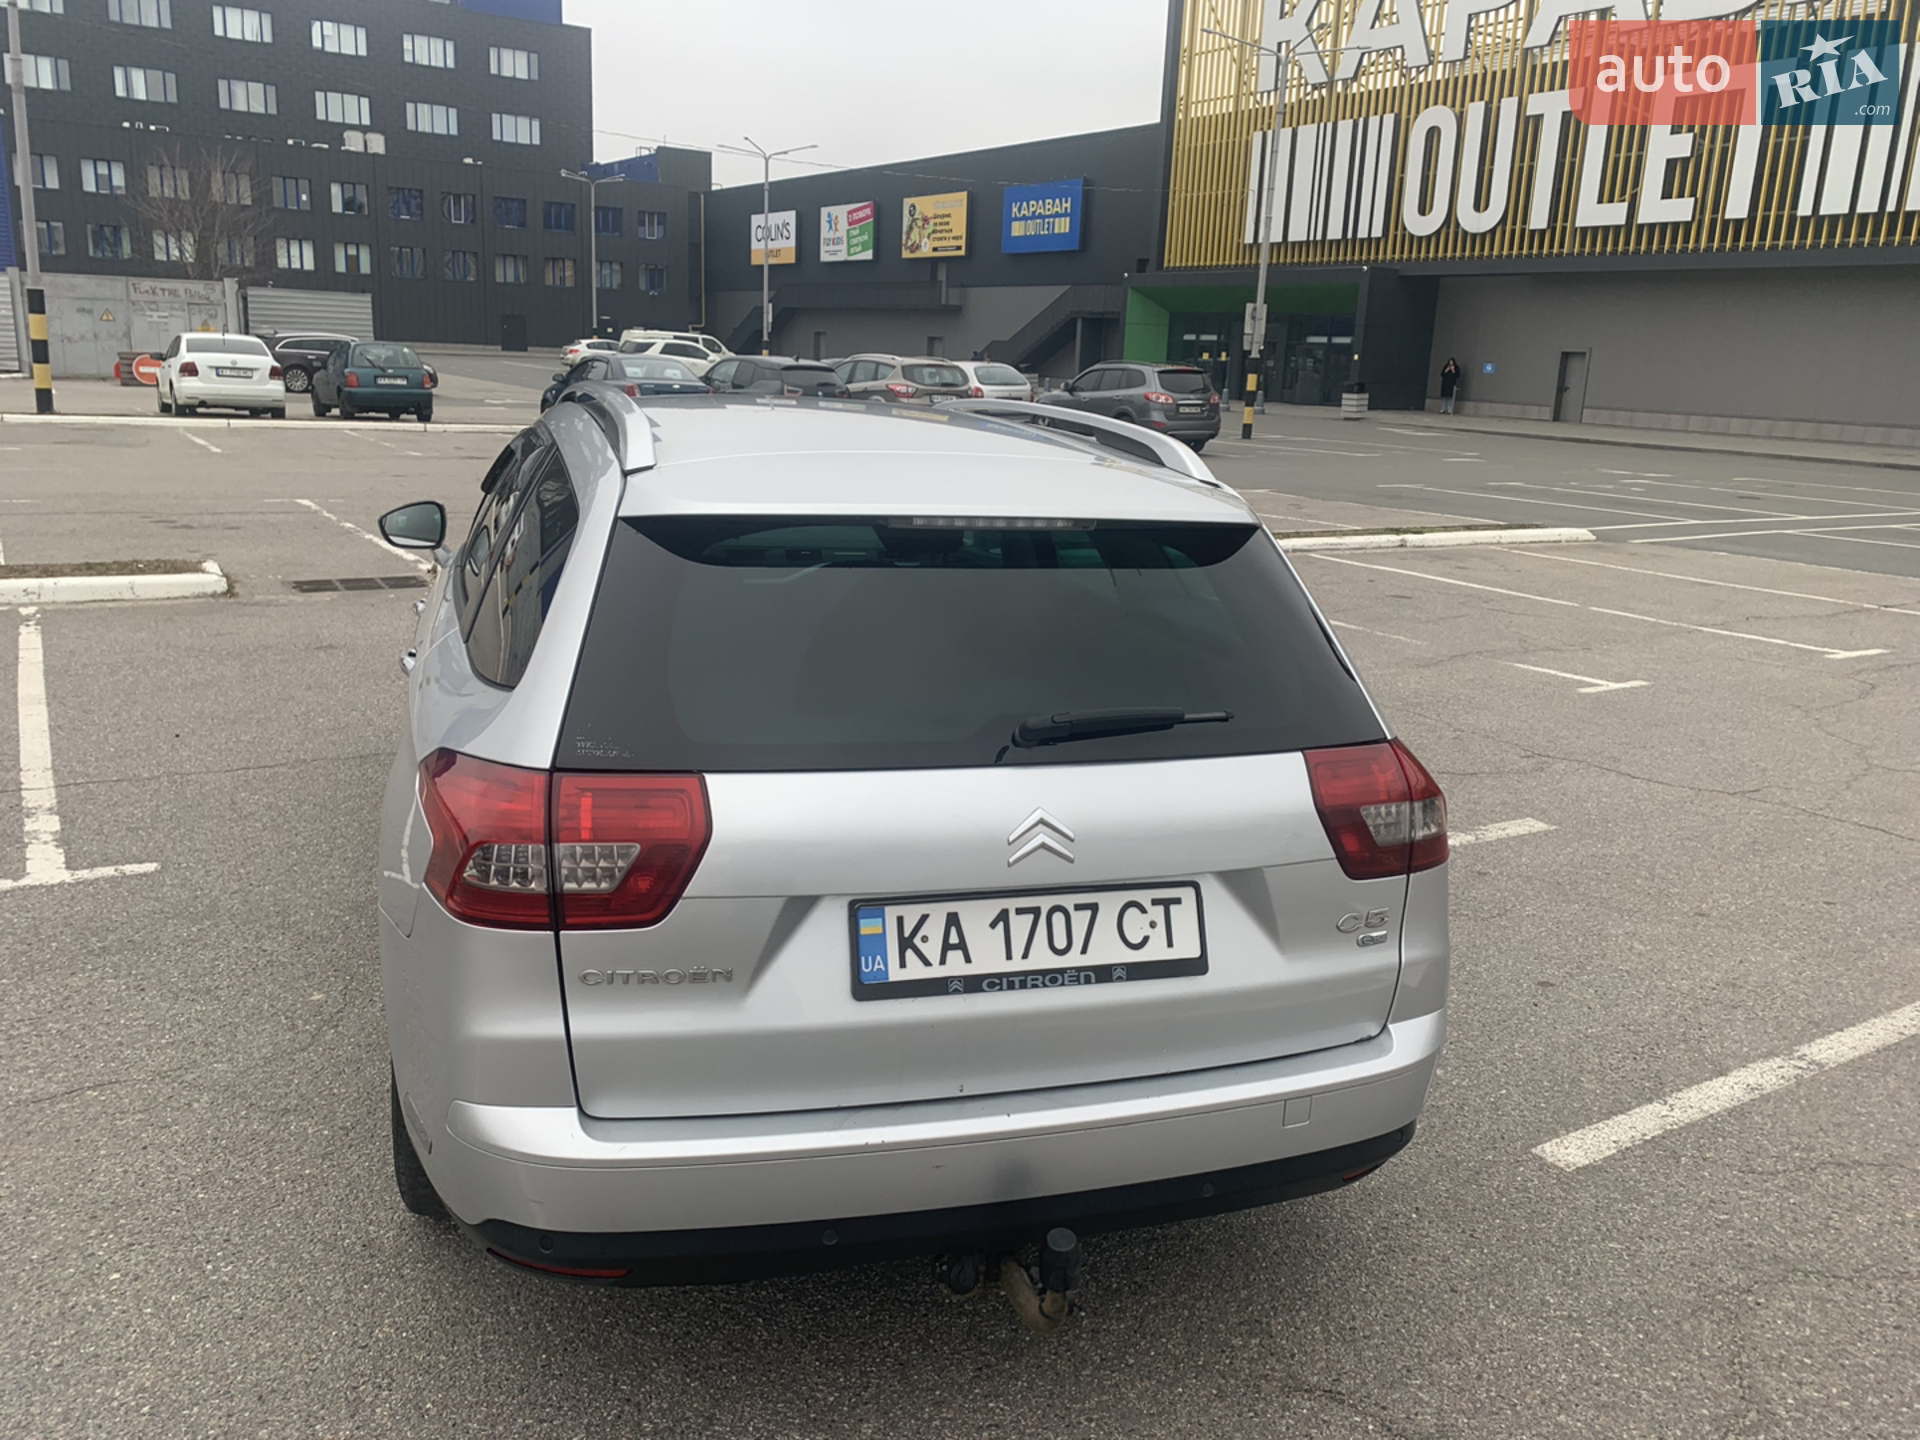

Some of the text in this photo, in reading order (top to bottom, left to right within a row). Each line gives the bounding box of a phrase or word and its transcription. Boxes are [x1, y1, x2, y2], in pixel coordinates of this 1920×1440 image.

[1401, 56, 1799, 237] OUTLET
[1011, 197, 1072, 218] КАРАВАН
[1025, 218, 1054, 236] OUTLET
[764, 248, 782, 258] UTLET
[1336, 906, 1390, 934] C5
[895, 897, 1182, 970] KA 1707 CT
[861, 955, 886, 974] UA
[578, 965, 734, 986] CITROËN
